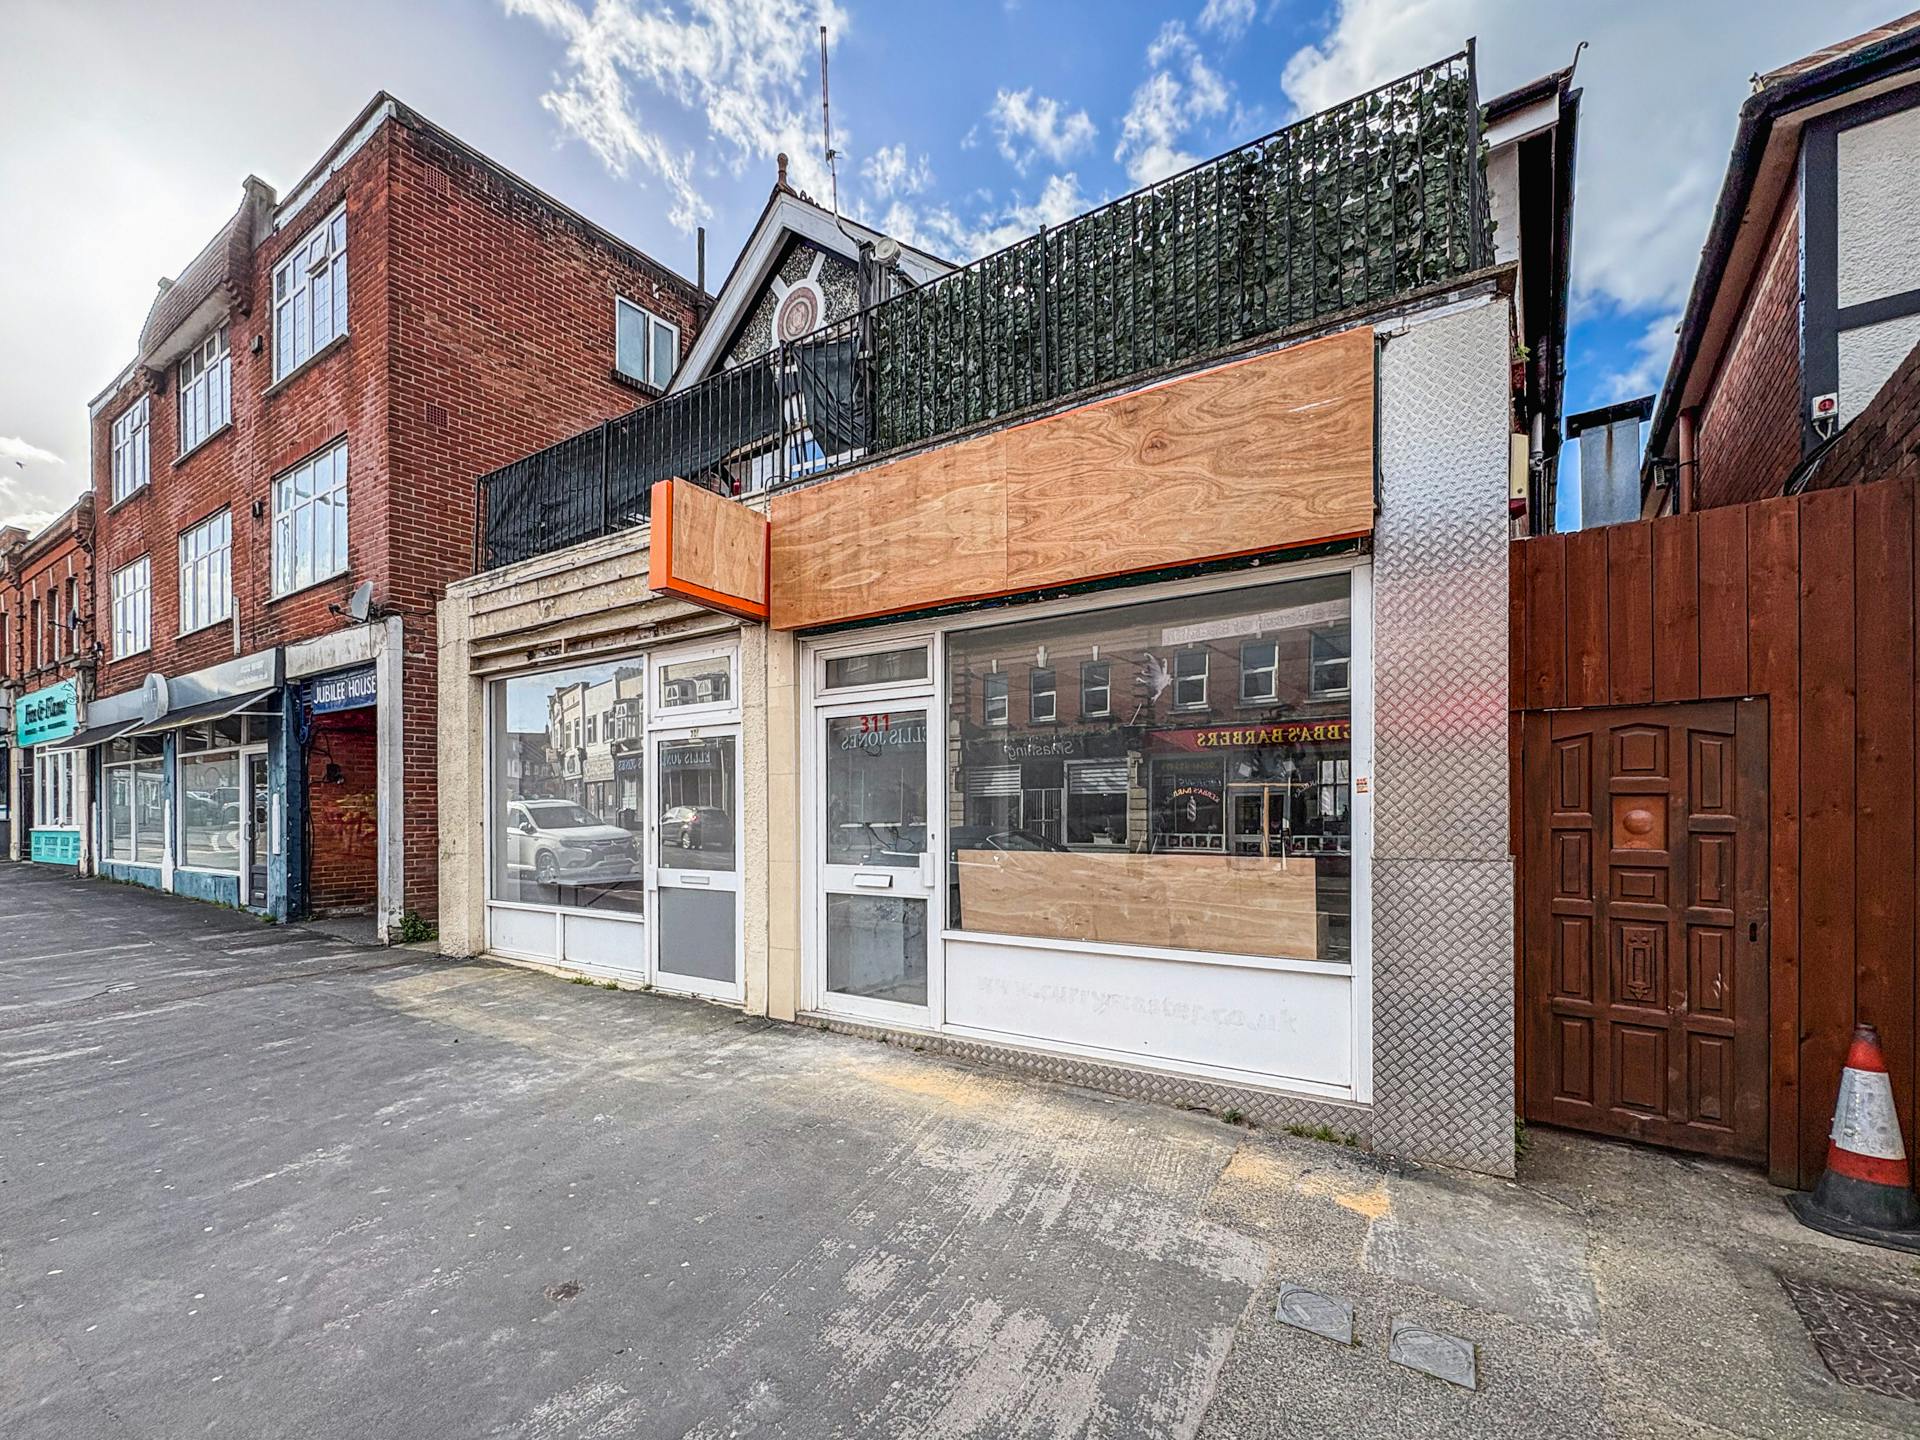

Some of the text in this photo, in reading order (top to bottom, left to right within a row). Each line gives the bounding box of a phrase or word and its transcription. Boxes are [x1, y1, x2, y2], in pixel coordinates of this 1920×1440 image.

[314, 675, 377, 704] JUBILEE HOUSE
[860, 713, 890, 733] 311
